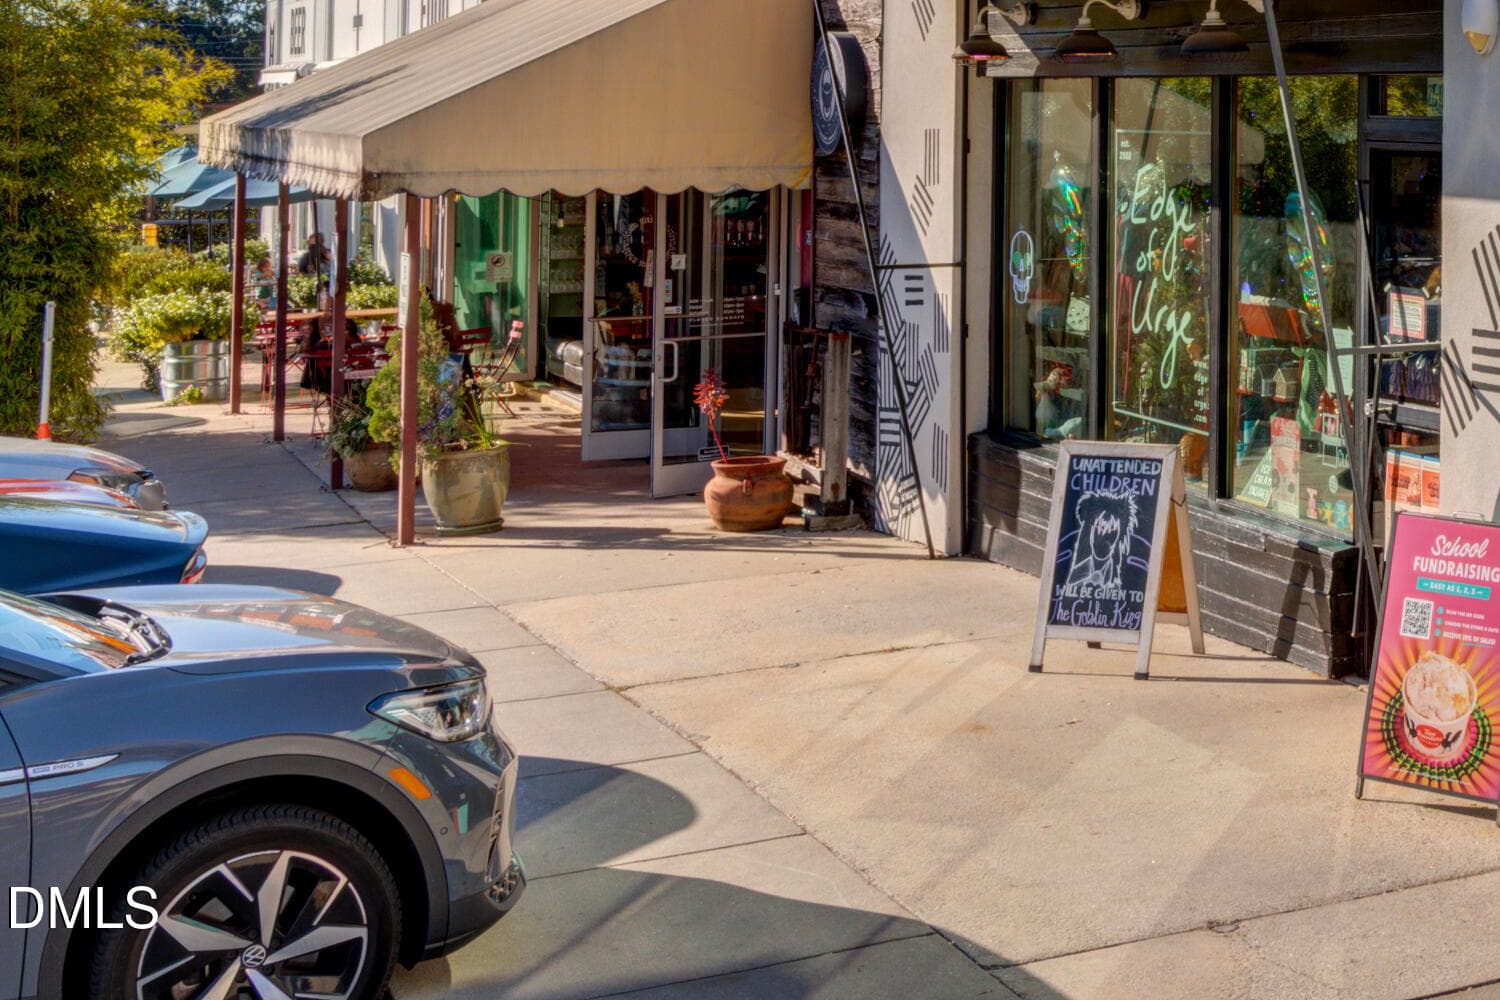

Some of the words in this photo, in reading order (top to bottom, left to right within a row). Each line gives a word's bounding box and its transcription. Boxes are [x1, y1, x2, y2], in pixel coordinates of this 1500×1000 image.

[290, 7, 306, 55] BEER
[1131, 162, 1196, 282] Edge
[1136, 227, 1159, 273] of
[1131, 276, 1195, 390] Urge
[1072, 458, 1161, 475] UNATTENDED
[1071, 473, 1156, 496] CHILDREN
[1431, 534, 1490, 559] School
[1413, 556, 1500, 583] FUNDRAISING
[1055, 584, 1078, 600] WILL
[1080, 585, 1093, 599] BE
[1095, 585, 1128, 601] GIVEN
[1130, 590, 1144, 603] TO
[1430, 581, 1445, 591] EASY
[1447, 583, 1455, 591] AS
[1050, 597, 1070, 622] The
[1071, 599, 1109, 627] Goblin
[1111, 601, 1142, 629] King
